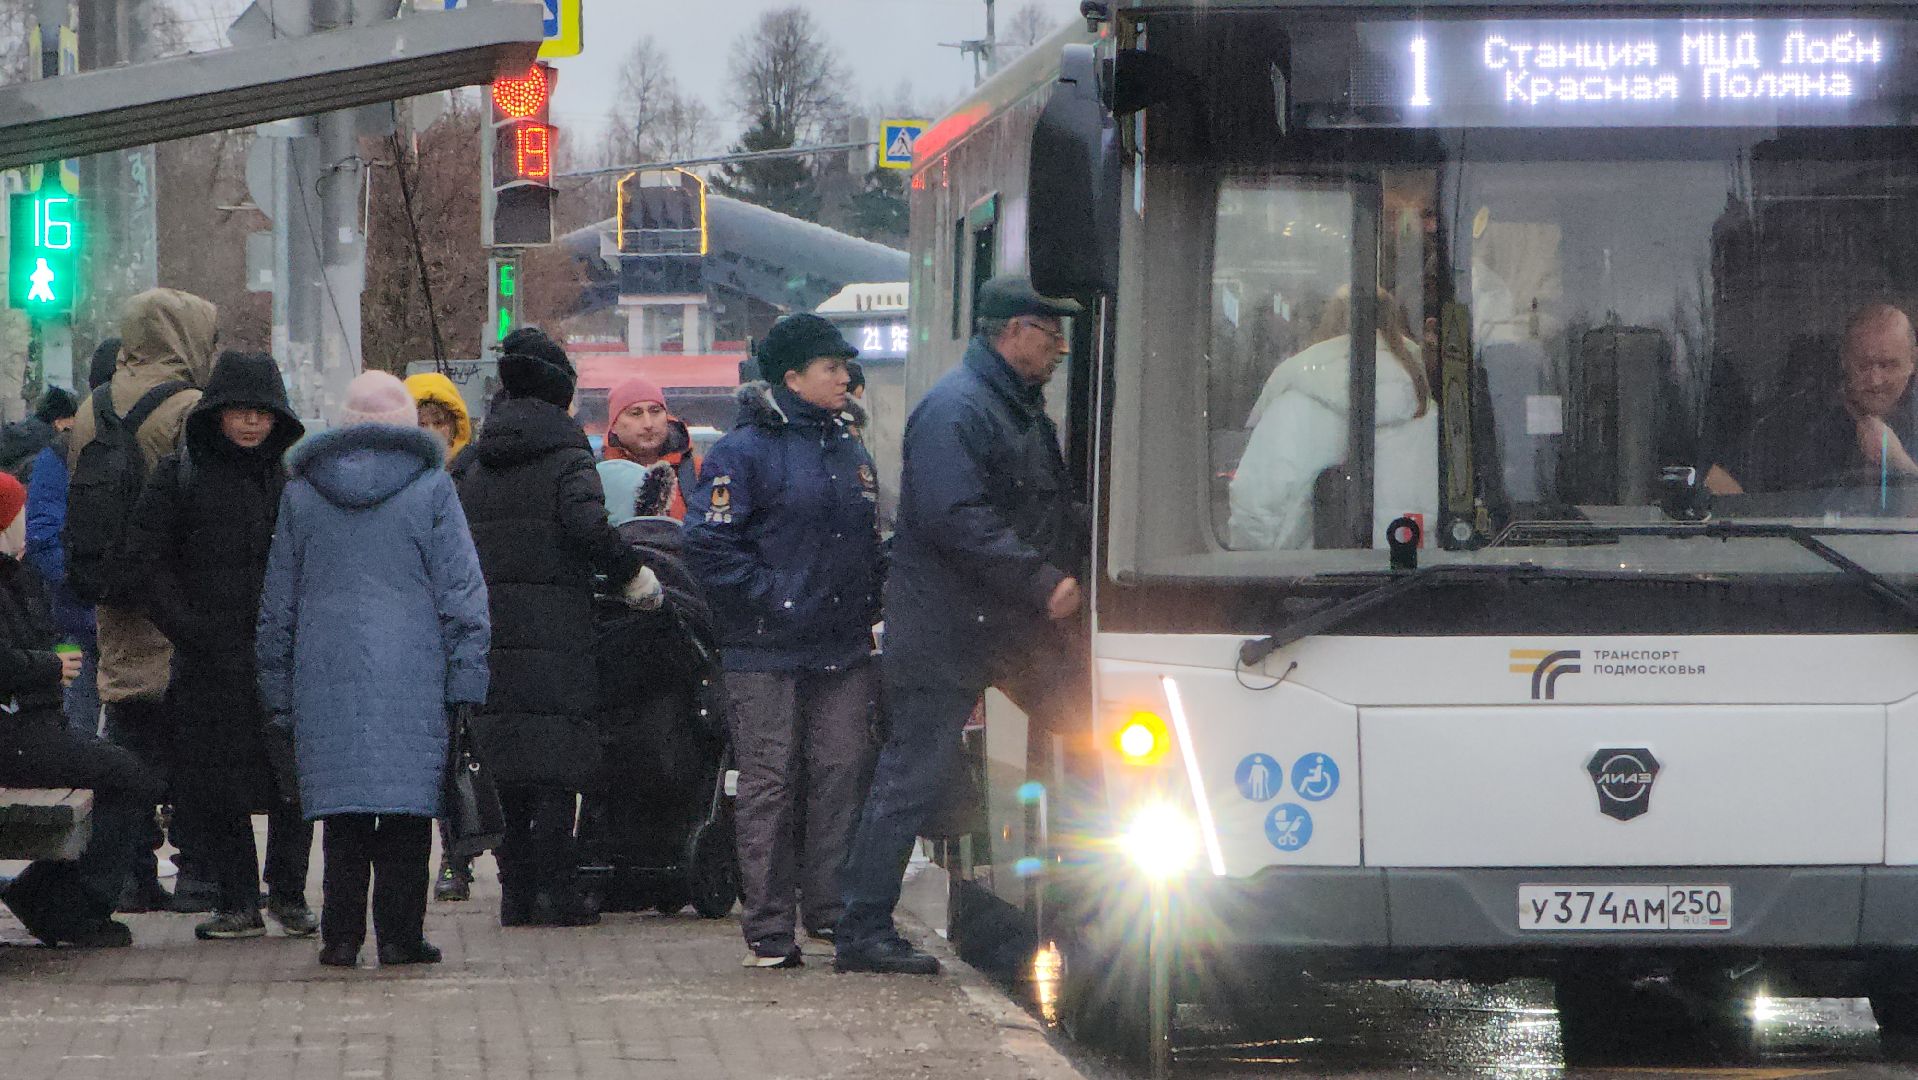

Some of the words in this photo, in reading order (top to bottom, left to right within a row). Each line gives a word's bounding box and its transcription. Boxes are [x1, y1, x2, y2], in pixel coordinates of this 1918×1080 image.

[1484, 33, 1658, 70] Станция
[1683, 32, 1760, 69] МЦД
[1780, 31, 1883, 65] Лобн
[1411, 37, 1431, 106] 1
[1505, 69, 1679, 104] Красная
[1703, 67, 1854, 100] Поляна
[517, 127, 547, 176] 19
[34, 198, 71, 250] 16
[500, 264, 514, 297] 6
[863, 326, 883, 351] 21
[1593, 650, 1680, 661] ТРАНСПОРТ
[1593, 664, 1706, 676] ПОДМОСКОВЬЯ
[1671, 890, 1721, 915] 250
[1683, 914, 1709, 925] RUS
